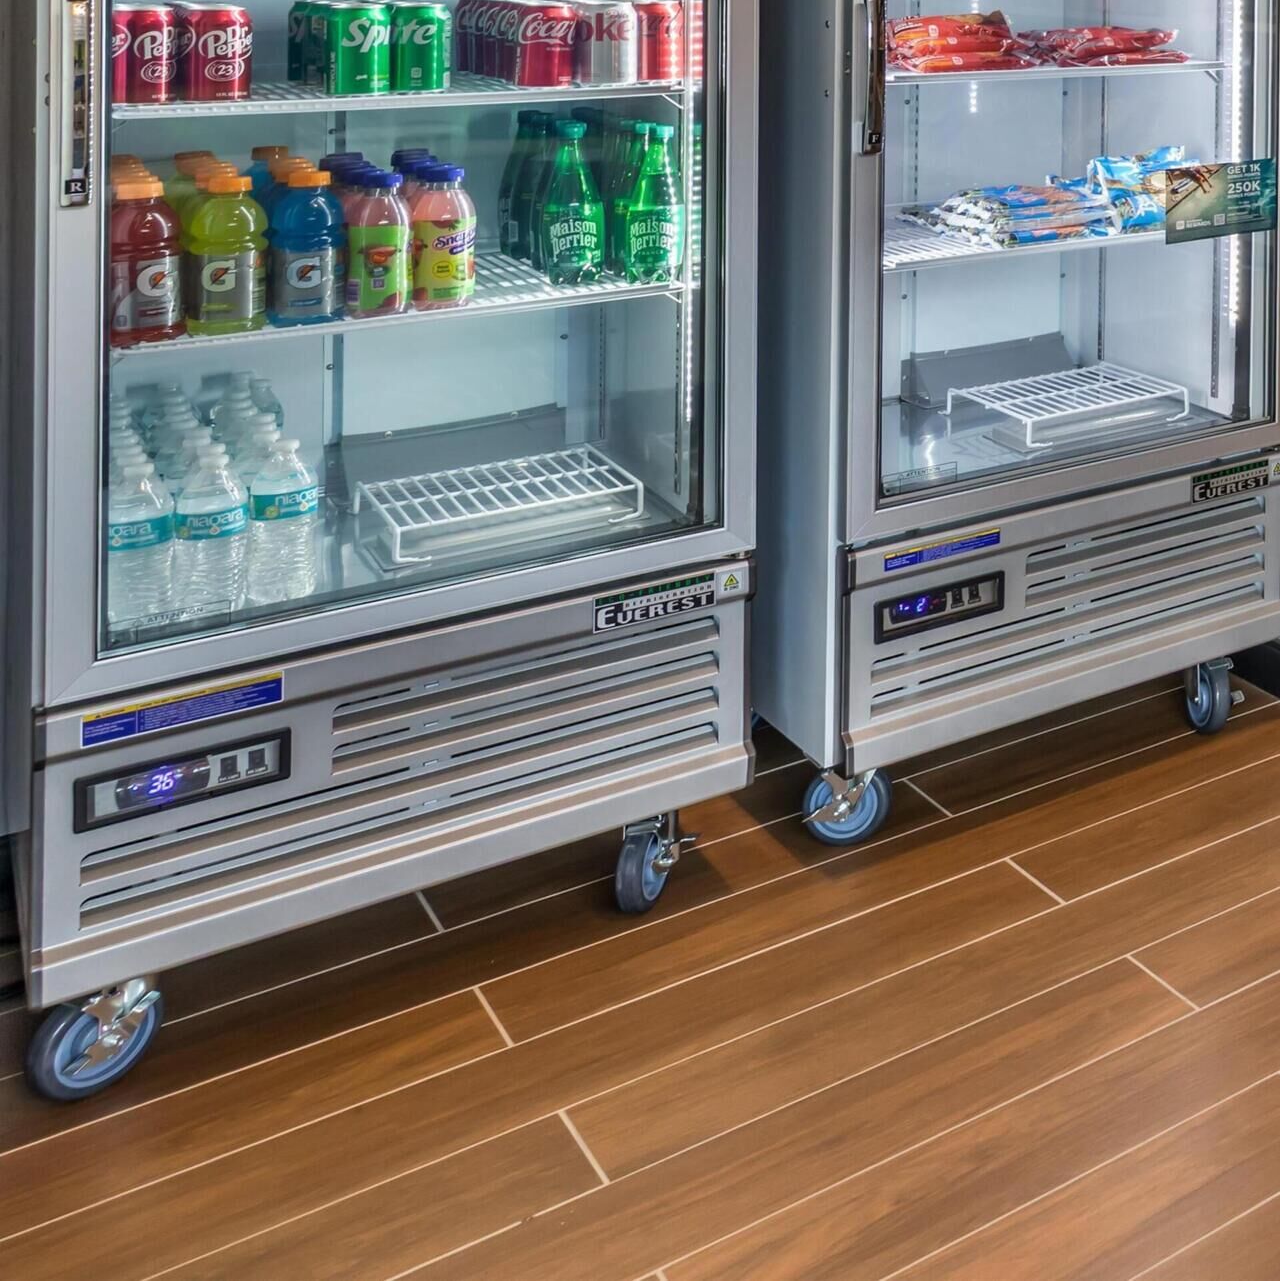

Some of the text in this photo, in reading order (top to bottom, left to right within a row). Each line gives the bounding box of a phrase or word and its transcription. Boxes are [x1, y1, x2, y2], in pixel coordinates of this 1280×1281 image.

[199, 30, 252, 59] Peppe
[218, 64, 233, 75] 23
[1227, 163, 1261, 175] GET 1K
[69, 182, 83, 192] R
[1227, 181, 1260, 194] 250K
[550, 218, 597, 238] Maison
[630, 219, 674, 237] Maison
[136, 266, 179, 296] G
[201, 260, 237, 292] G
[287, 257, 321, 289] G
[1194, 476, 1267, 501] EVEREST
[597, 592, 713, 629] EVEREST
[149, 772, 174, 794] 36
